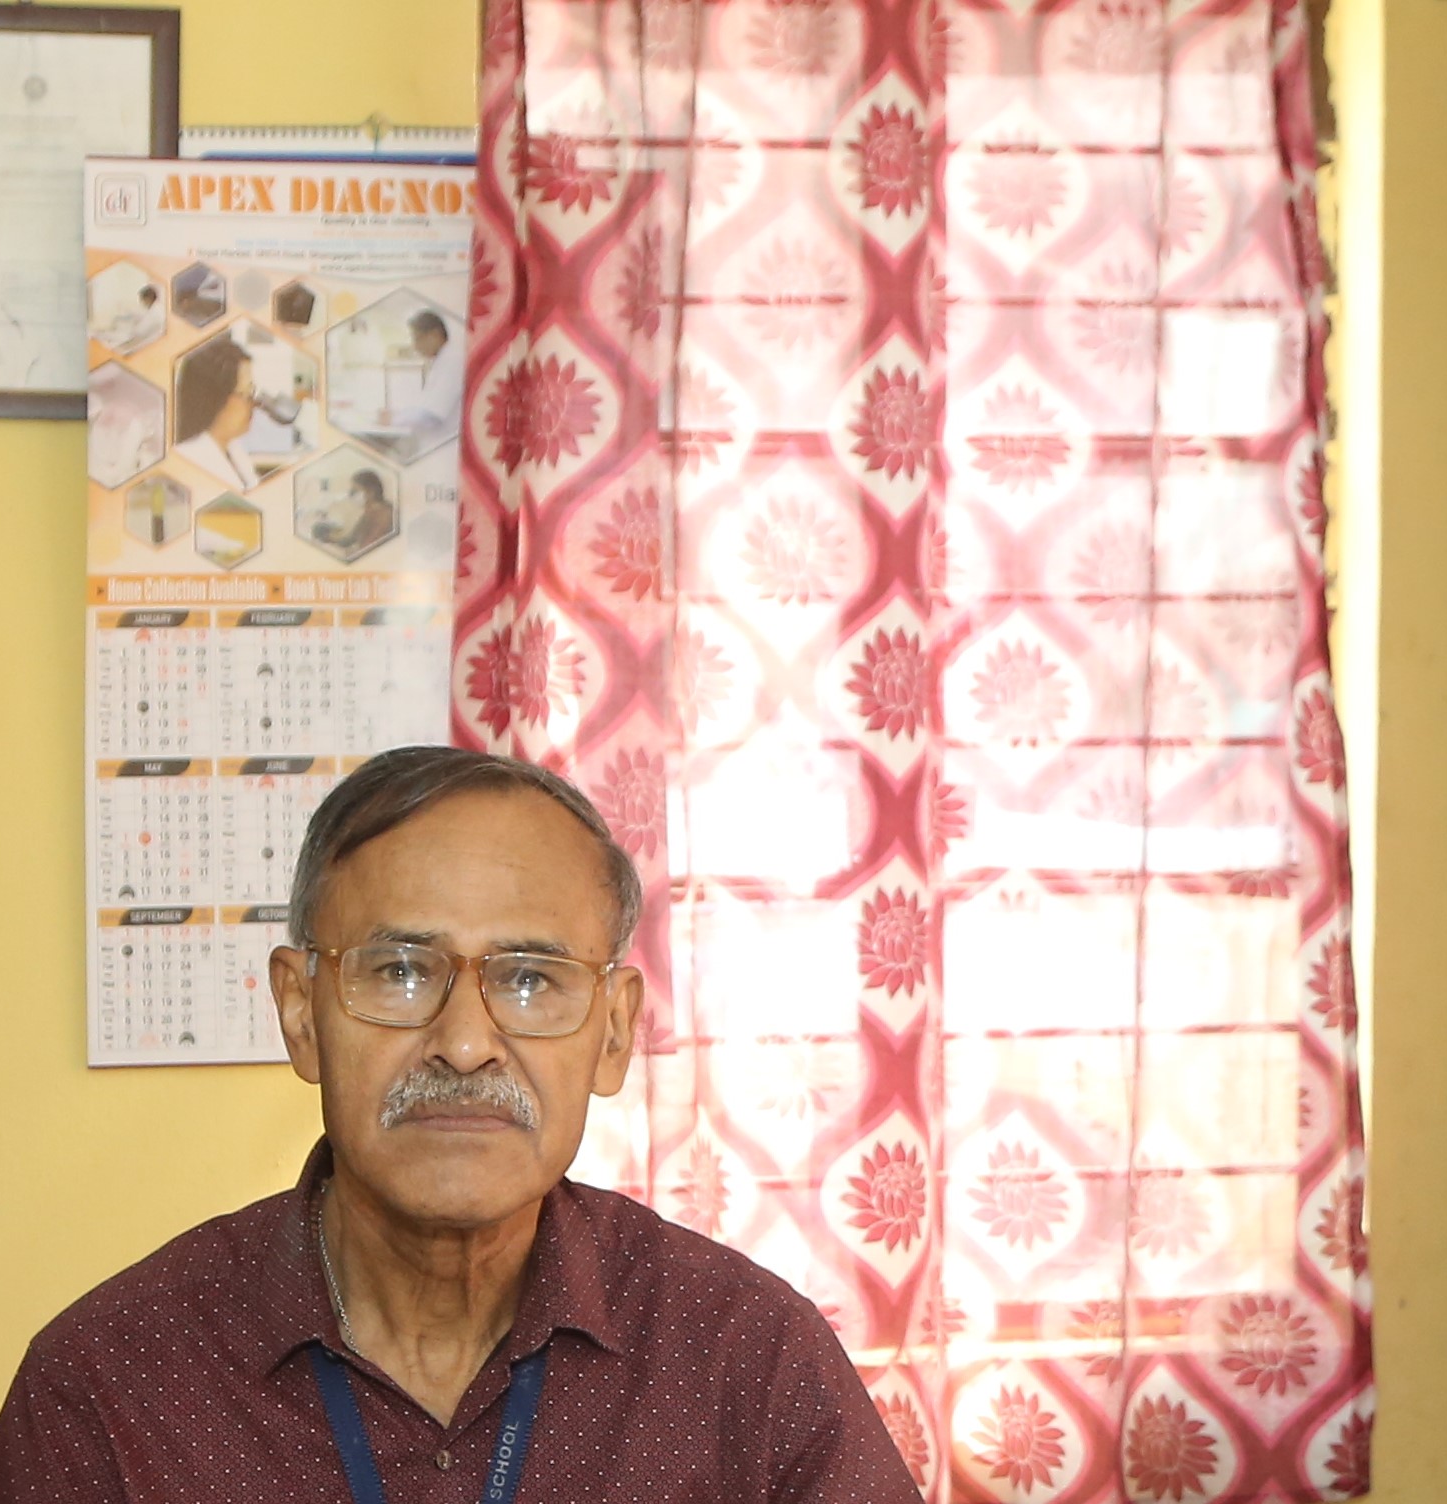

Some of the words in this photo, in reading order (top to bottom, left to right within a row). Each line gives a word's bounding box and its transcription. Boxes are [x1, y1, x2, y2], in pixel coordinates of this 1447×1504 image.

[158, 173, 276, 213] APEX
[108, 578, 142, 601] Home
[143, 578, 205, 601] Collection
[134, 613, 172, 624] JANUARY
[250, 613, 297, 624] FEBRUARY
[143, 762, 162, 772] MAY
[266, 761, 287, 771] JUNE
[129, 911, 182, 922] SEPTEMBER
[257, 909, 289, 920] OCTOB
[490, 1421, 520, 1500] SCHOOL
